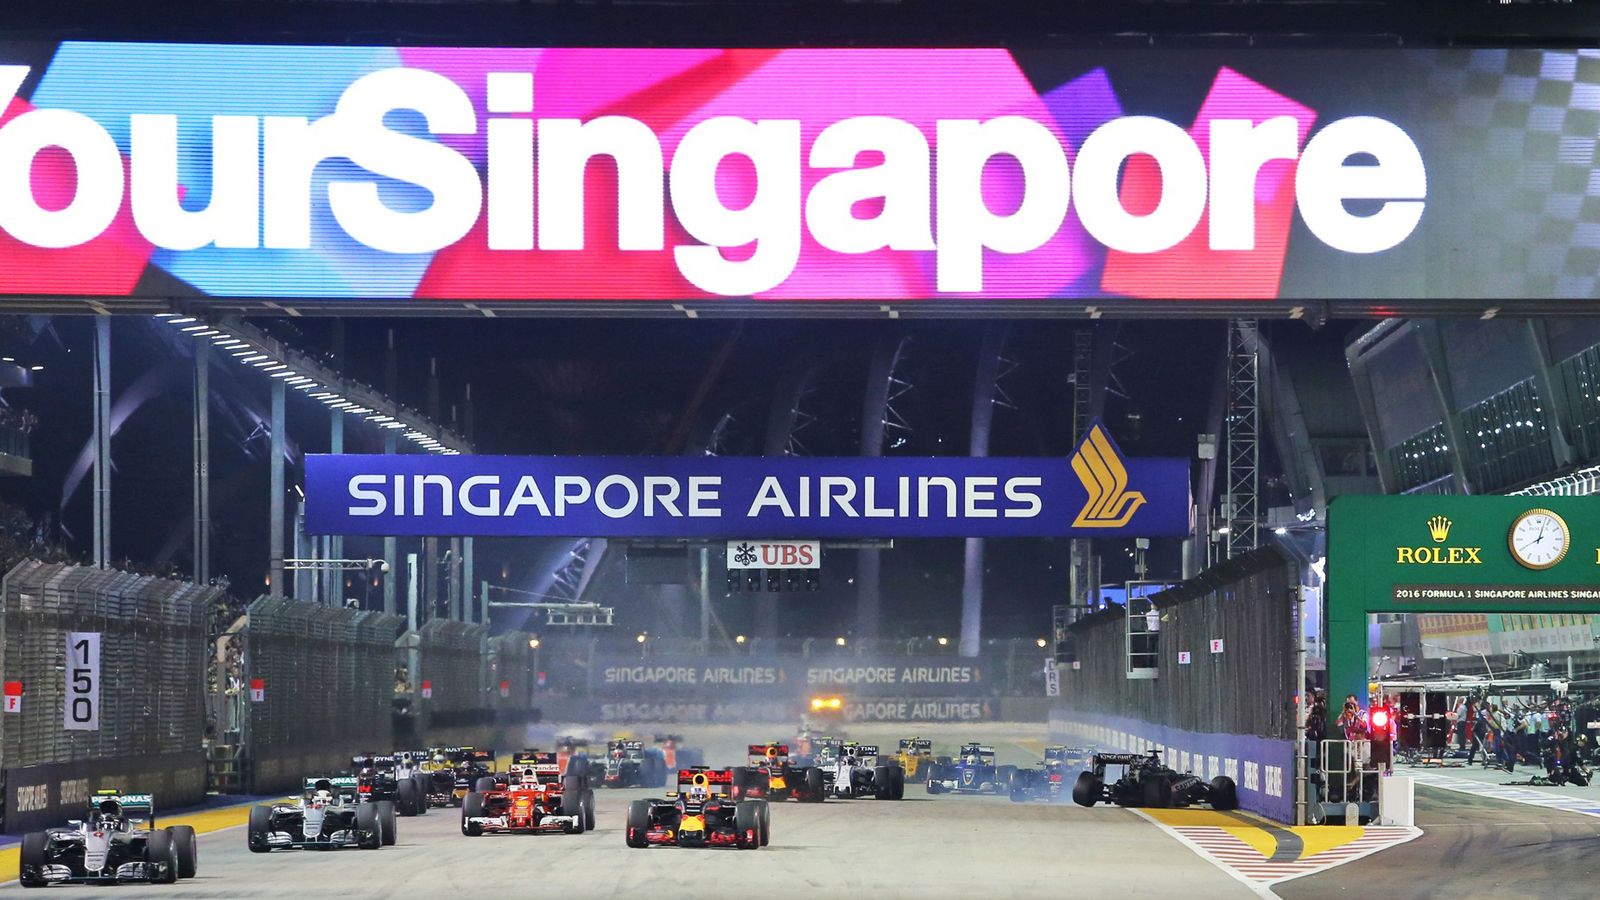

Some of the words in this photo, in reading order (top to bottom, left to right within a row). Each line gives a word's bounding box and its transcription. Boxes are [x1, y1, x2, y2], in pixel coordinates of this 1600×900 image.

[348, 474, 722, 519] SINGAPORE
[747, 476, 1043, 518] AIRLINES
[761, 544, 814, 565] UBS
[1396, 547, 1482, 564] ROLEX
[1396, 590, 1420, 598] 2016
[1422, 590, 1464, 598] FORMULA
[1467, 590, 1472, 598] 1
[1474, 590, 1526, 598] SINGAPORE
[1528, 590, 1569, 598] AIRLINES
[1570, 590, 1600, 598] SINGA
[73, 640, 92, 722] 150
[605, 667, 697, 684] SINGAPORE
[703, 668, 776, 684] AIRLINES
[807, 667, 896, 684] SINGAPORE
[902, 667, 971, 683] AIRLINES
[912, 703, 981, 719] AIRLINES
